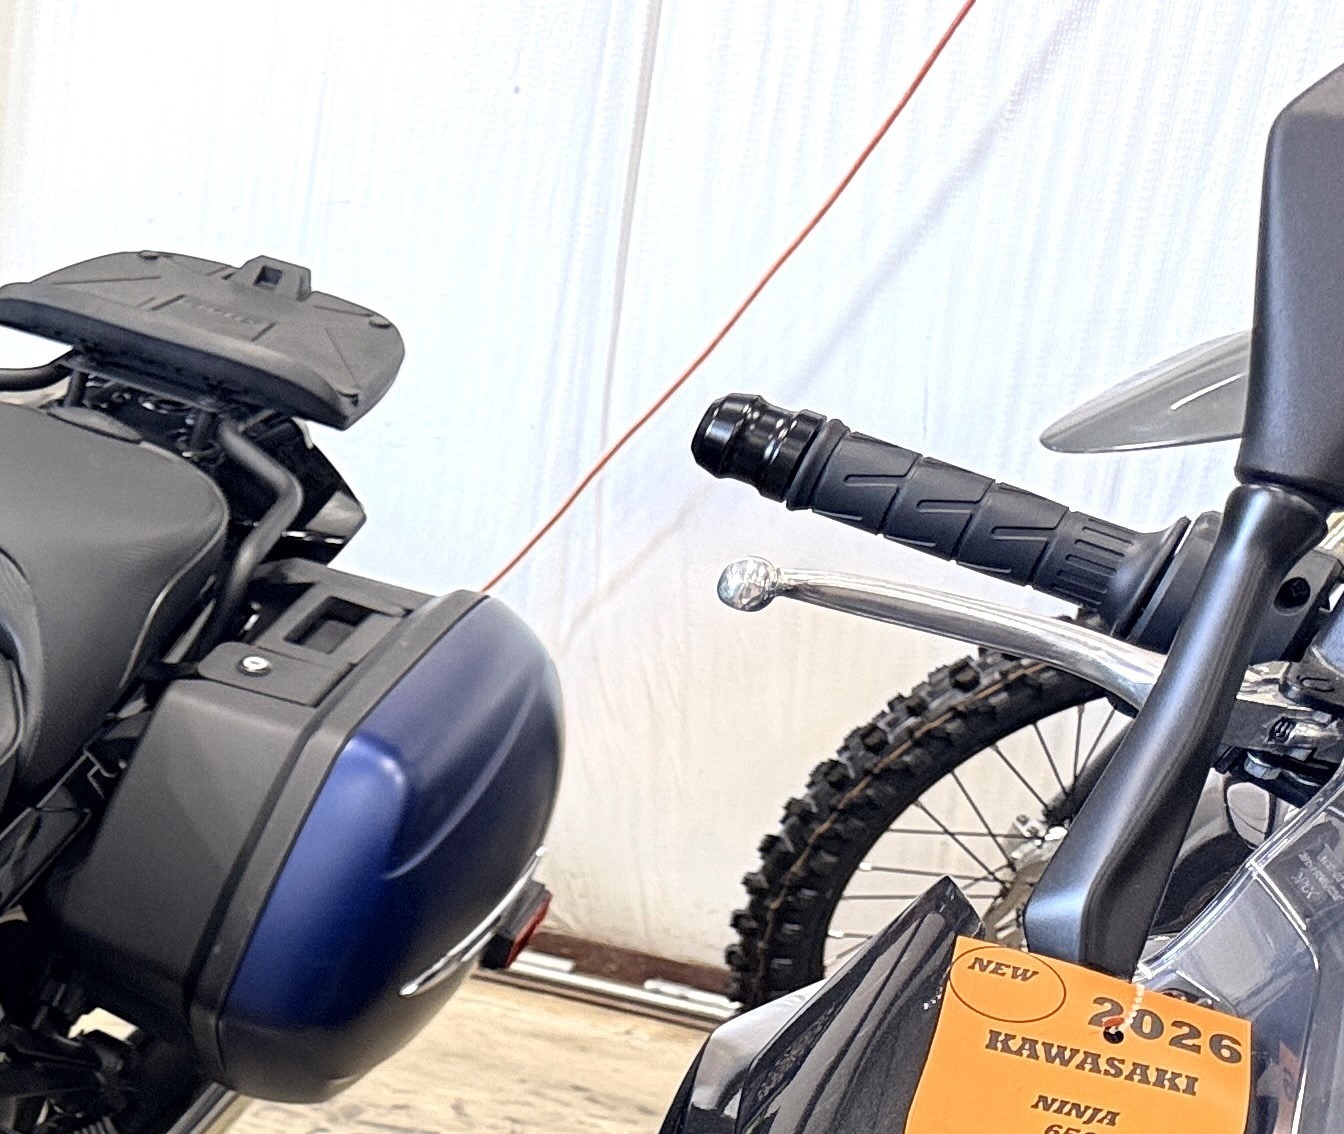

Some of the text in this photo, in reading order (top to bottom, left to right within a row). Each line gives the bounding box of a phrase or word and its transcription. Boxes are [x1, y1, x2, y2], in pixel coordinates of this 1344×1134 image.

[967, 956, 1040, 983] NEW
[1087, 996, 1244, 1064] 2026
[984, 1029, 1200, 1097] KAWASAKI
[1030, 1094, 1122, 1127] NINJA
